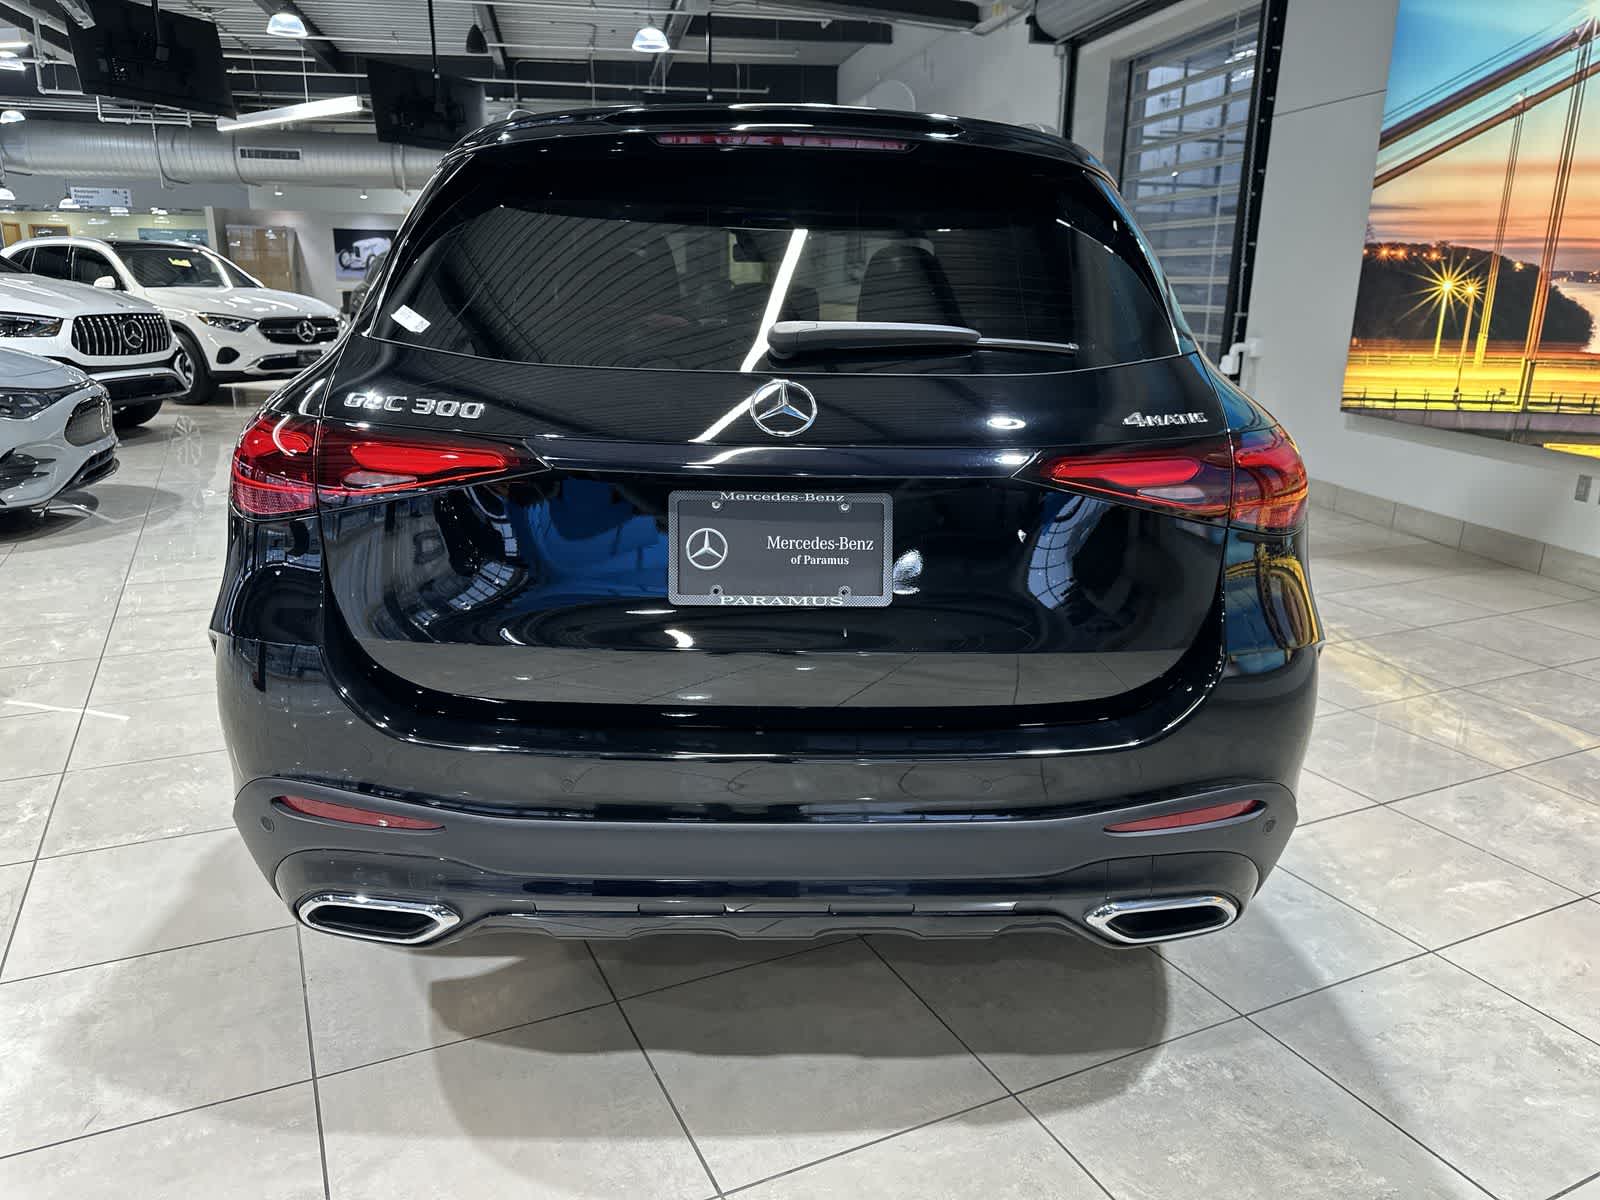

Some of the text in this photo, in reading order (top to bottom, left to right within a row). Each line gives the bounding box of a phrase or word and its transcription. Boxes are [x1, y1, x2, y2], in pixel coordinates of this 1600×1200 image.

[343, 391, 485, 419] GLC 300
[1122, 411, 1209, 428] 4MATIC
[719, 491, 846, 502] Mercedes-Benz
[766, 535, 875, 551] Mercedes-Benz
[790, 555, 850, 565] of Paramus
[719, 596, 844, 607] PARAMUS
